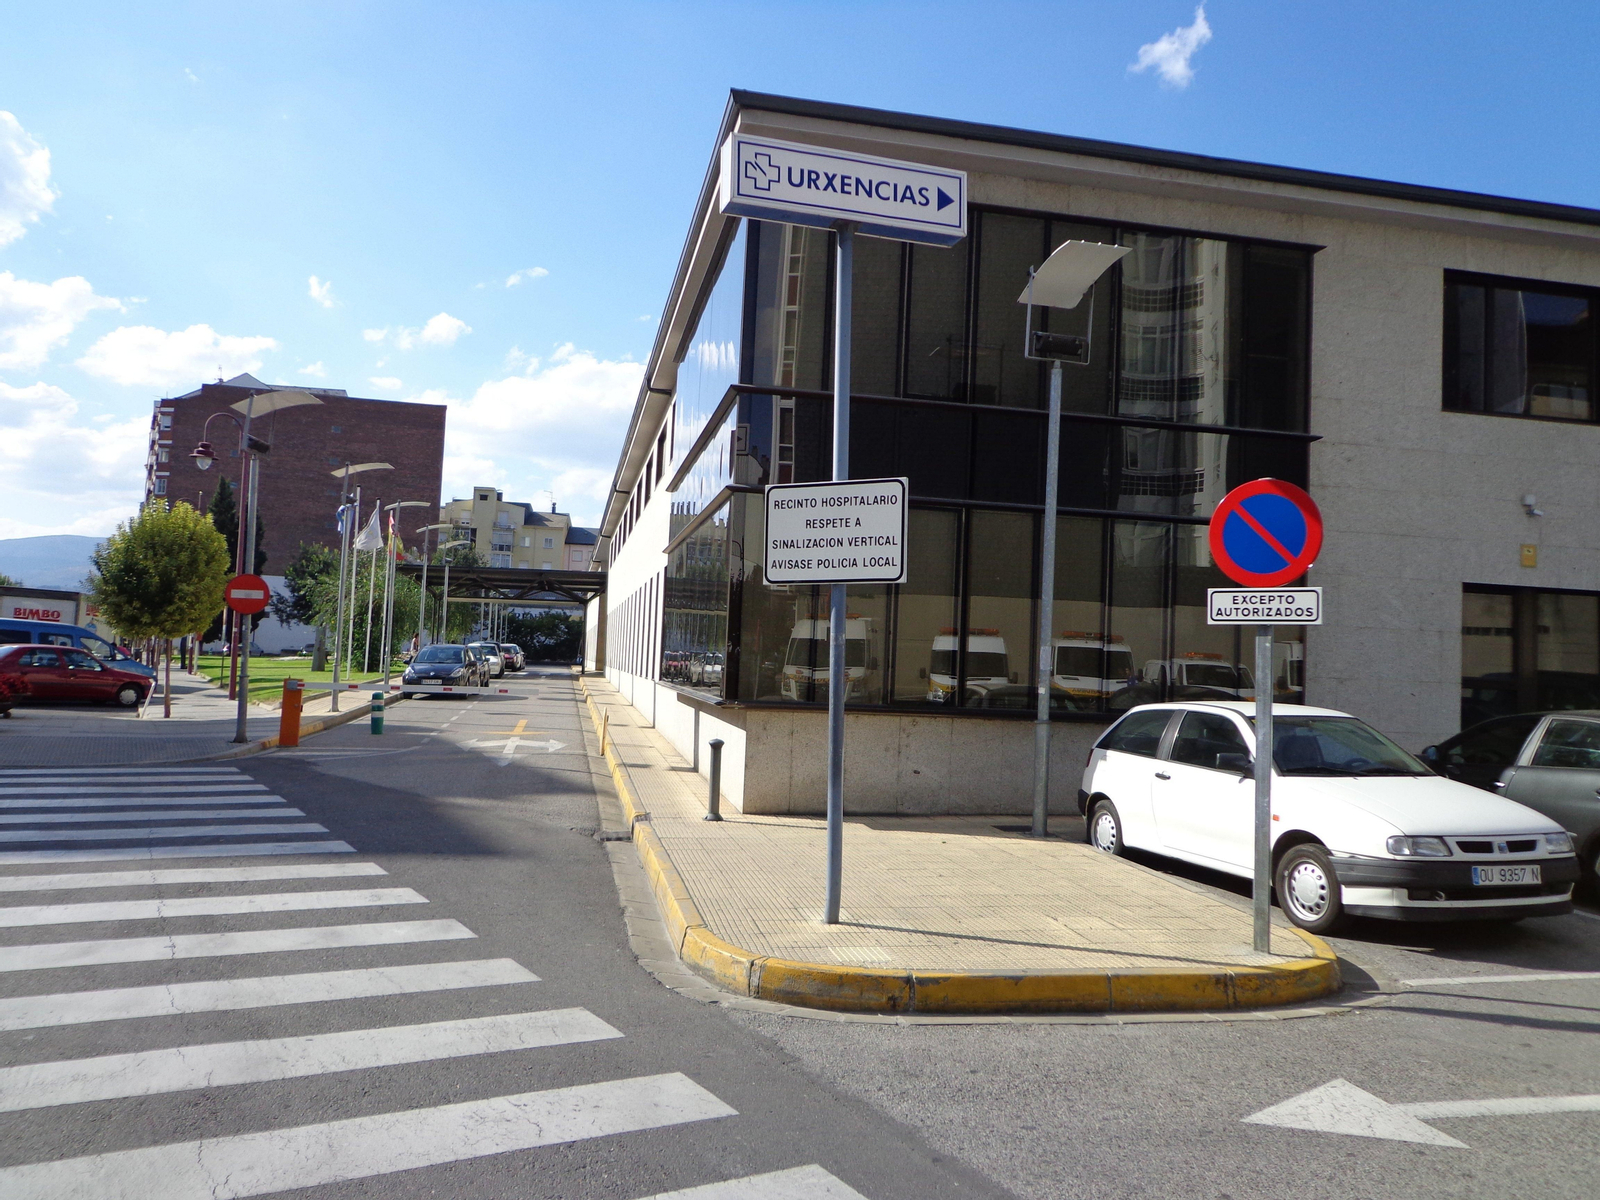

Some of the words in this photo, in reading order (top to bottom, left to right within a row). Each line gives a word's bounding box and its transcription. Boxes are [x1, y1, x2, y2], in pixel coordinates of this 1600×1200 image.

[787, 166, 930, 206] URXENCIAS
[774, 498, 817, 510] RECINTO
[821, 494, 898, 507] HOSPITALARIO
[805, 517, 851, 529] RESPETE
[854, 517, 862, 527] A
[772, 537, 844, 549] SINALIZACION
[847, 535, 898, 547] VERTICAL
[771, 559, 813, 570] AVISASE
[817, 558, 858, 569] POLICIA
[863, 556, 898, 567] LOCAL
[1232, 595, 1296, 605] EXCEPTO
[13, 607, 61, 620] BIMBO
[1215, 607, 1314, 617] AUTORIZADOS
[1480, 868, 1494, 882] OU
[1499, 868, 1526, 882] 9357
[1531, 867, 1539, 882] N
